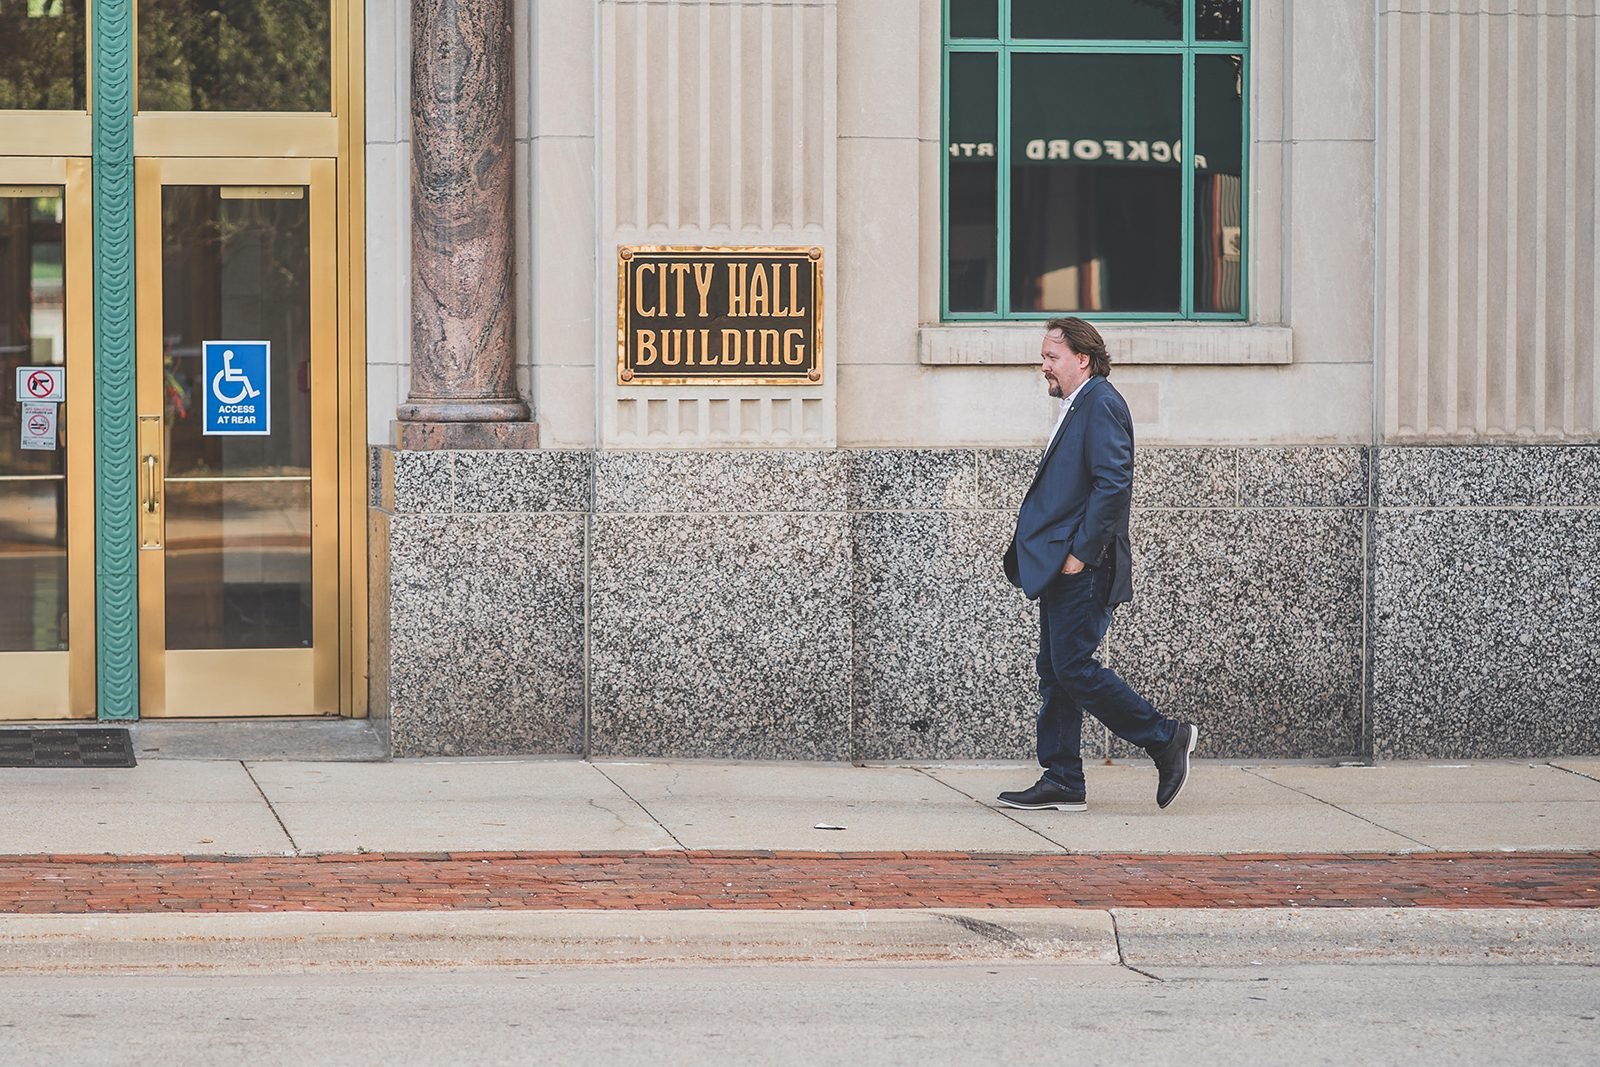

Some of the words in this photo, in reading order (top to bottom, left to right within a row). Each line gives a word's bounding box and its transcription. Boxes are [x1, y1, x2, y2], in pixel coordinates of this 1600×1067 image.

[635, 263, 715, 317] CITY
[727, 263, 805, 317] HALL
[635, 328, 805, 366] BUILDING
[217, 416, 230, 424] AT
[231, 416, 256, 424] REAR
[218, 405, 255, 414] ACCESS
